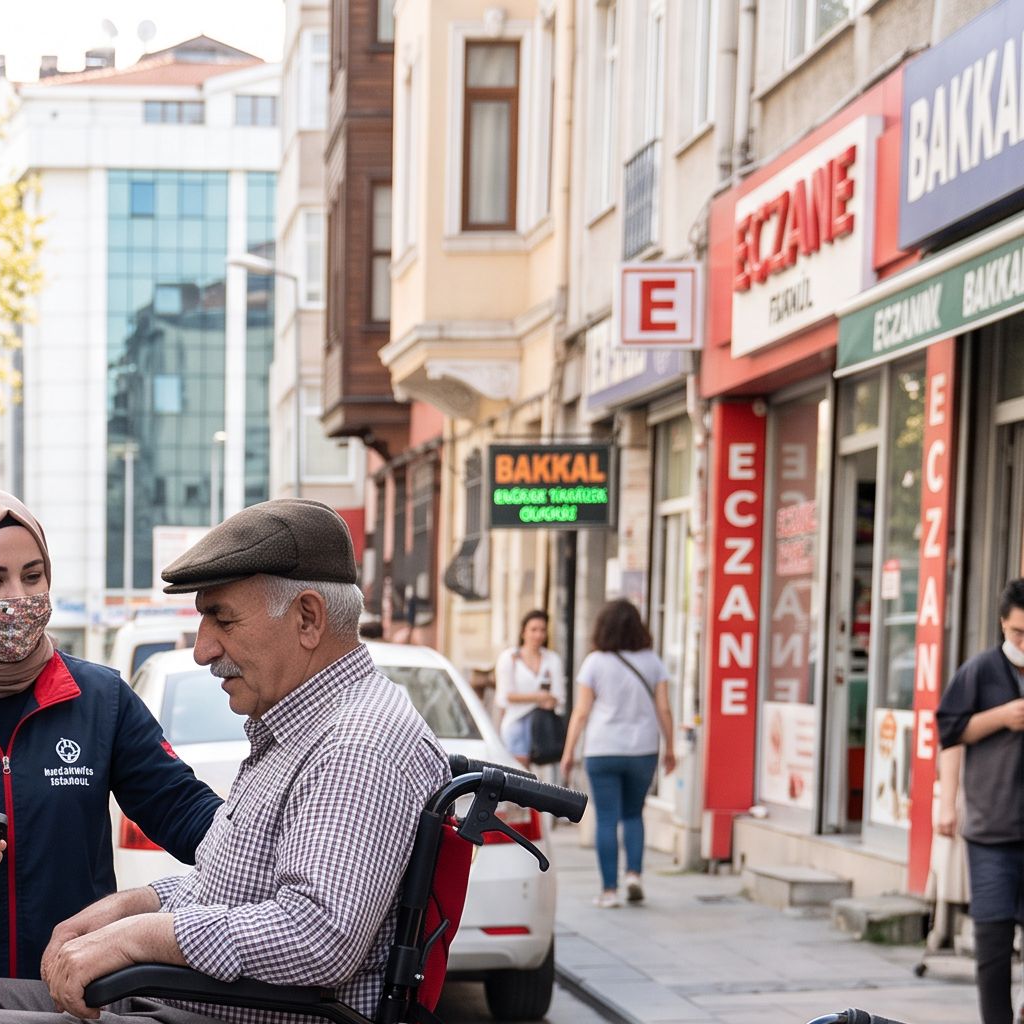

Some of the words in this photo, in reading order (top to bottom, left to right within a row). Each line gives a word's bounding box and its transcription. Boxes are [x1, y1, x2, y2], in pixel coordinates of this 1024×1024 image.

[907, 29, 1024, 203] BAKKA
[734, 145, 857, 292] ECZANE
[962, 246, 1024, 318] BAKKA
[640, 280, 677, 331] E
[495, 453, 607, 485] BAKKAL
[718, 443, 757, 716] ECZANE
[916, 373, 946, 760] ECZANE
